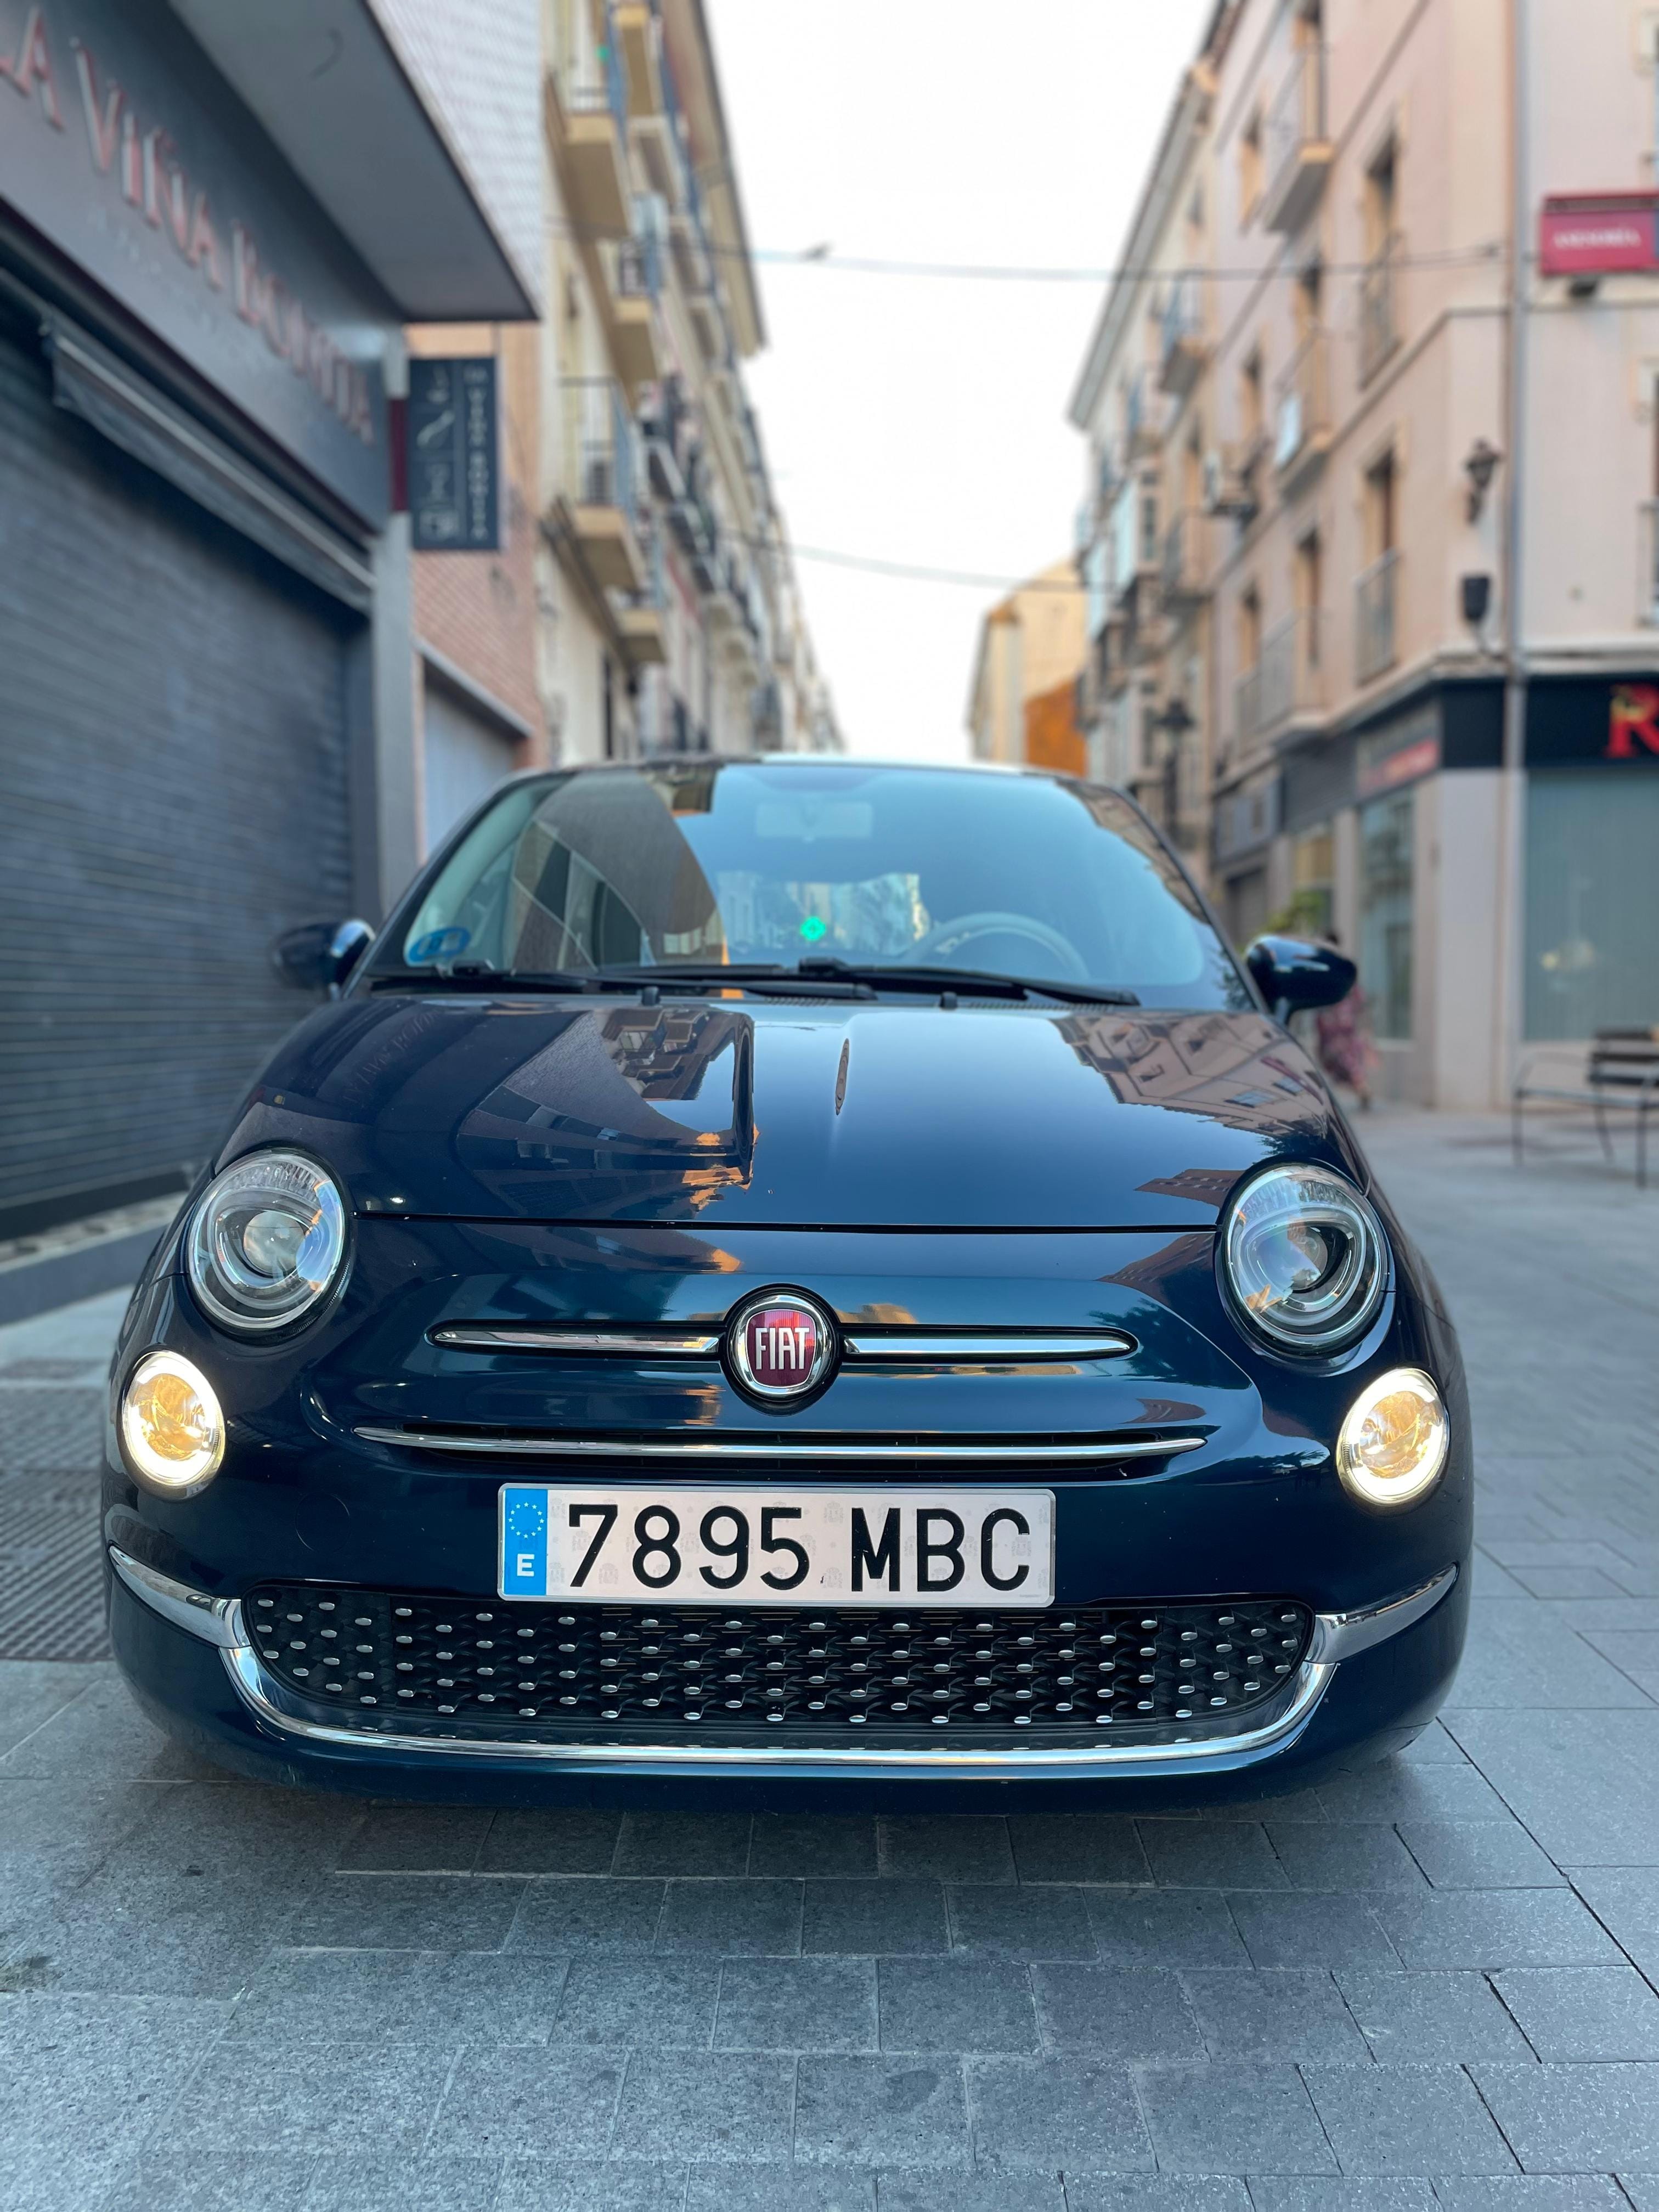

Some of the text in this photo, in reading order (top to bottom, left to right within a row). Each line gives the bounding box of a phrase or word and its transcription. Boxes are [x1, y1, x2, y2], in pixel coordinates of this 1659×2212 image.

[0, 1, 65, 133] A
[755, 1327, 810, 1370] FIAT
[517, 1554, 534, 1577] E
[569, 1504, 1030, 1593] 7895 MBC
